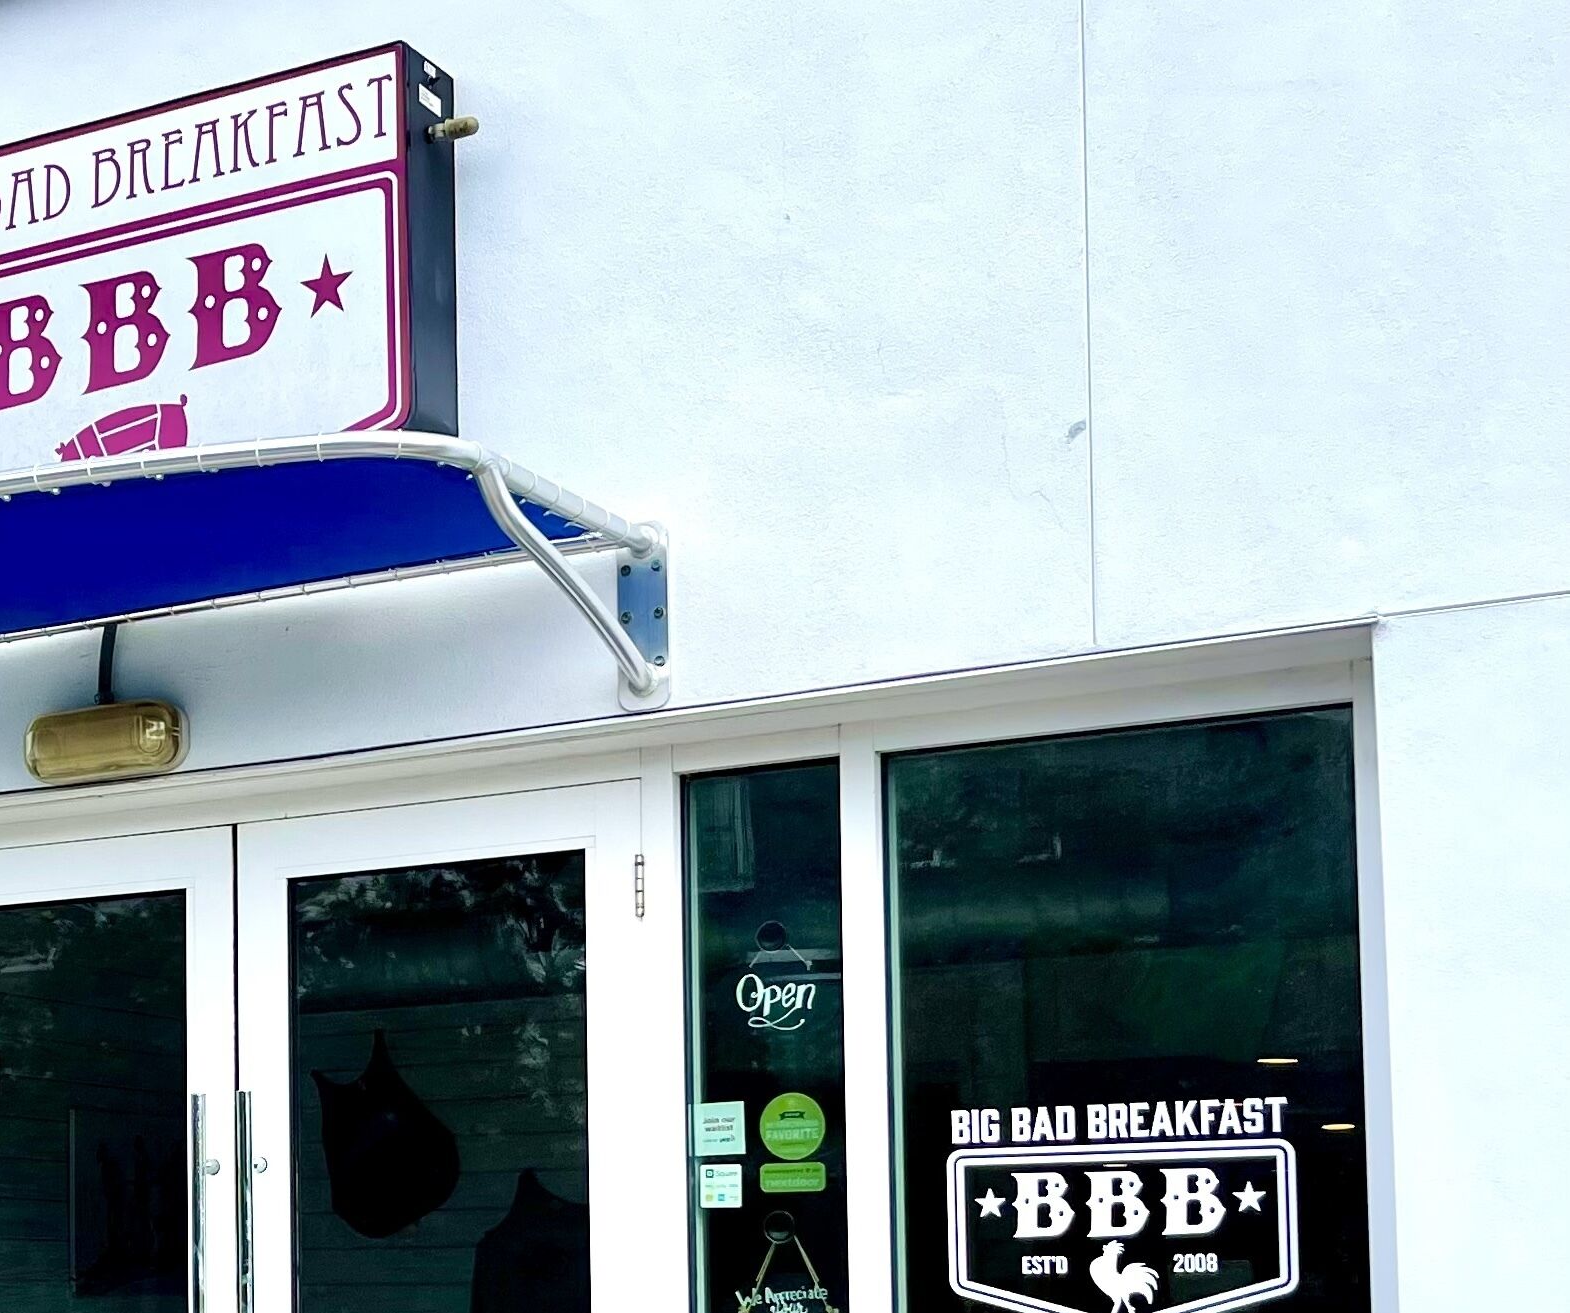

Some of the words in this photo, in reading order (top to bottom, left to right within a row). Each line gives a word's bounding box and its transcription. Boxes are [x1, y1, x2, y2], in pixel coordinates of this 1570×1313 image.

[91, 74, 393, 209] BREAKFAST
[735, 973, 816, 1024] Open
[765, 1128, 819, 1140] FAVORITE
[950, 1108, 1001, 1144] BIG
[1011, 1105, 1076, 1142] BAD
[1087, 1096, 1289, 1139] BREAKFAST
[1011, 1167, 1227, 1239] BBB
[1021, 1254, 1069, 1276] EST'D
[1173, 1253, 1219, 1274] 2008
